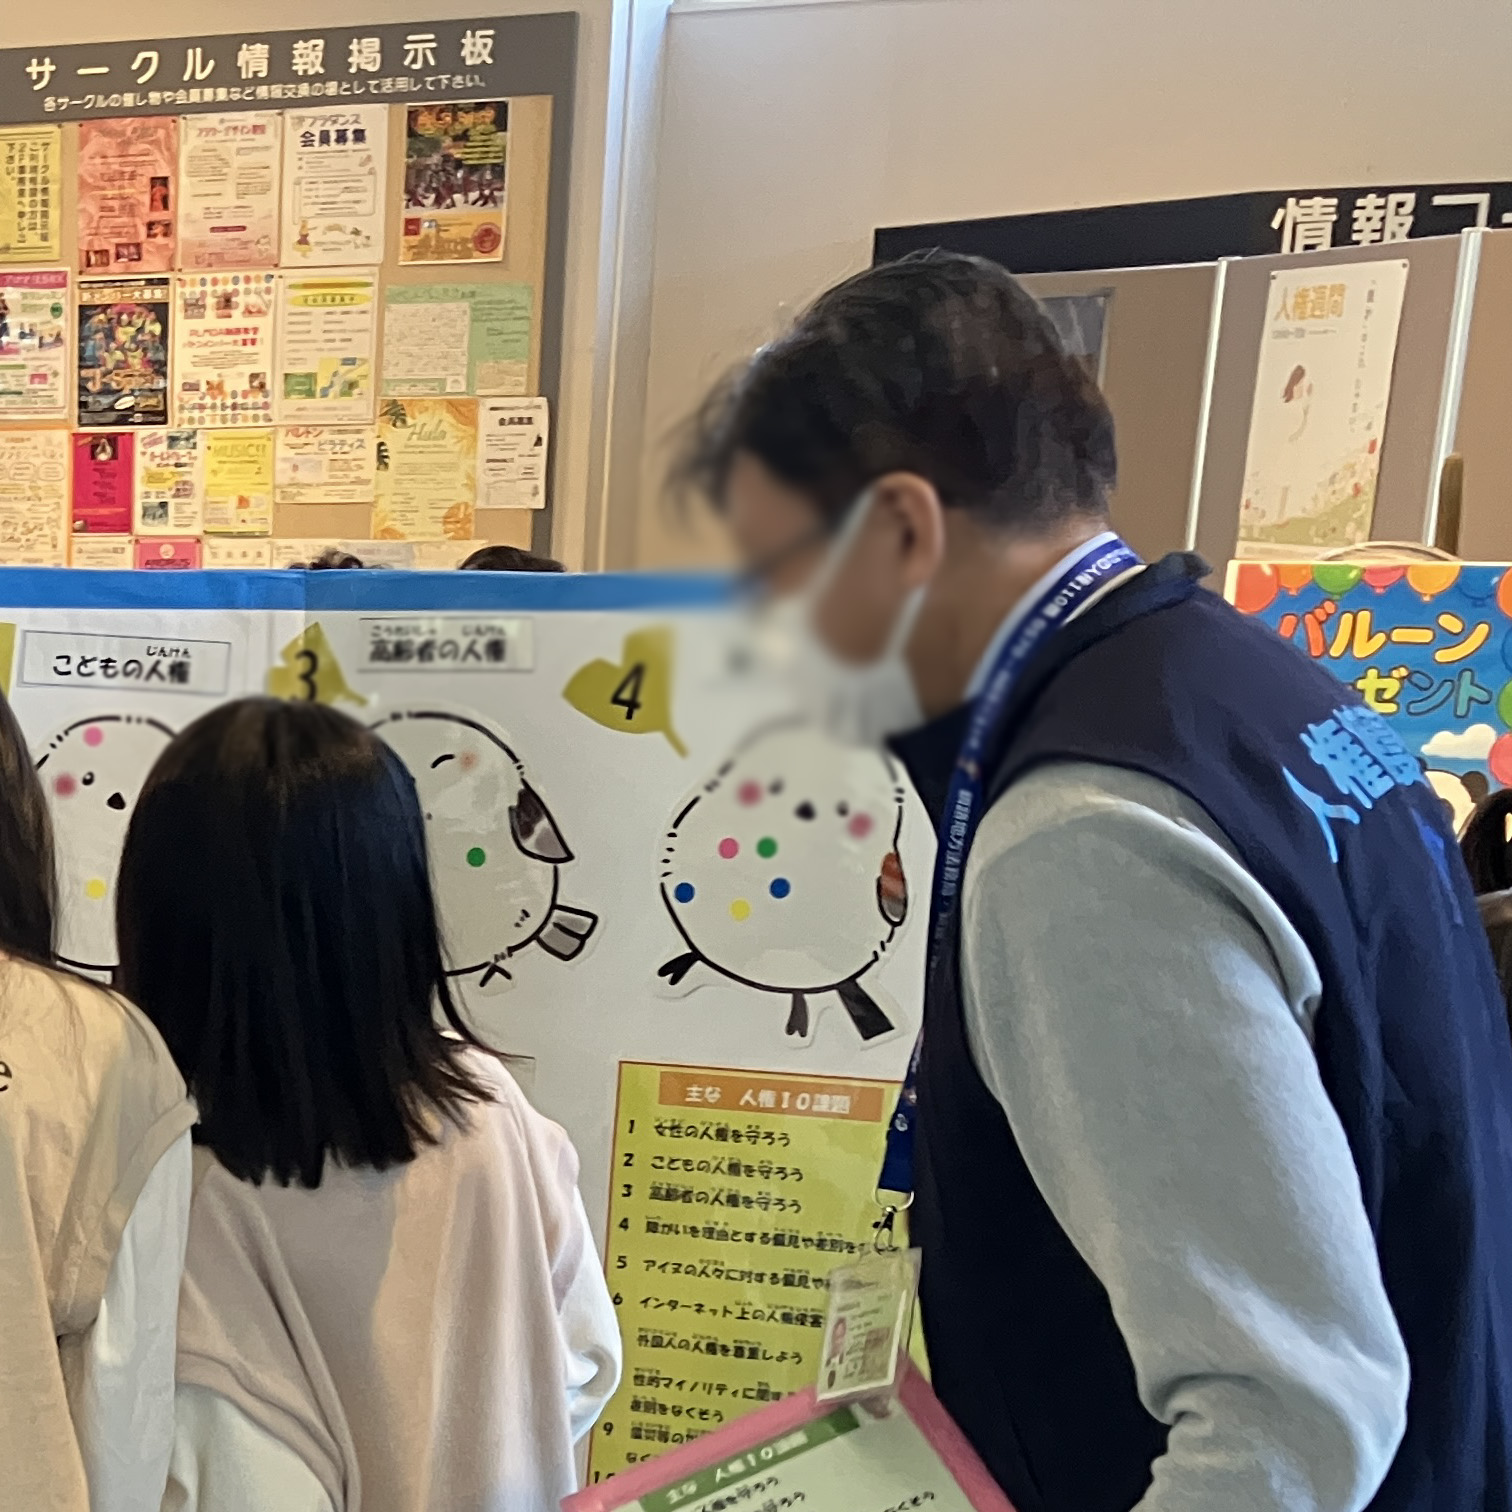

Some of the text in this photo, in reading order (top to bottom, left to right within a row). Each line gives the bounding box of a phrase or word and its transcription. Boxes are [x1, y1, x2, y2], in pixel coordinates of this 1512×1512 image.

[26, 30, 495, 91] サークル情報掲示板
[299, 128, 367, 148] 会員募集
[1271, 191, 1512, 254] 情報コ
[1278, 600, 1491, 665] バルーン
[53, 654, 191, 684] こどもの人権
[295, 649, 318, 702] 3
[612, 662, 646, 720] 4
[1350, 665, 1493, 719] ゼント
[628, 1119, 791, 1148] 1 女性の人権を守ろう
[623, 1153, 804, 1182] 2 こどもの人権を守ろう
[621, 1184, 632, 1198] 3
[619, 1218, 630, 1231] 4
[616, 1255, 628, 1269] 5
[612, 1293, 624, 1306] 6
[603, 1422, 614, 1436] 9
